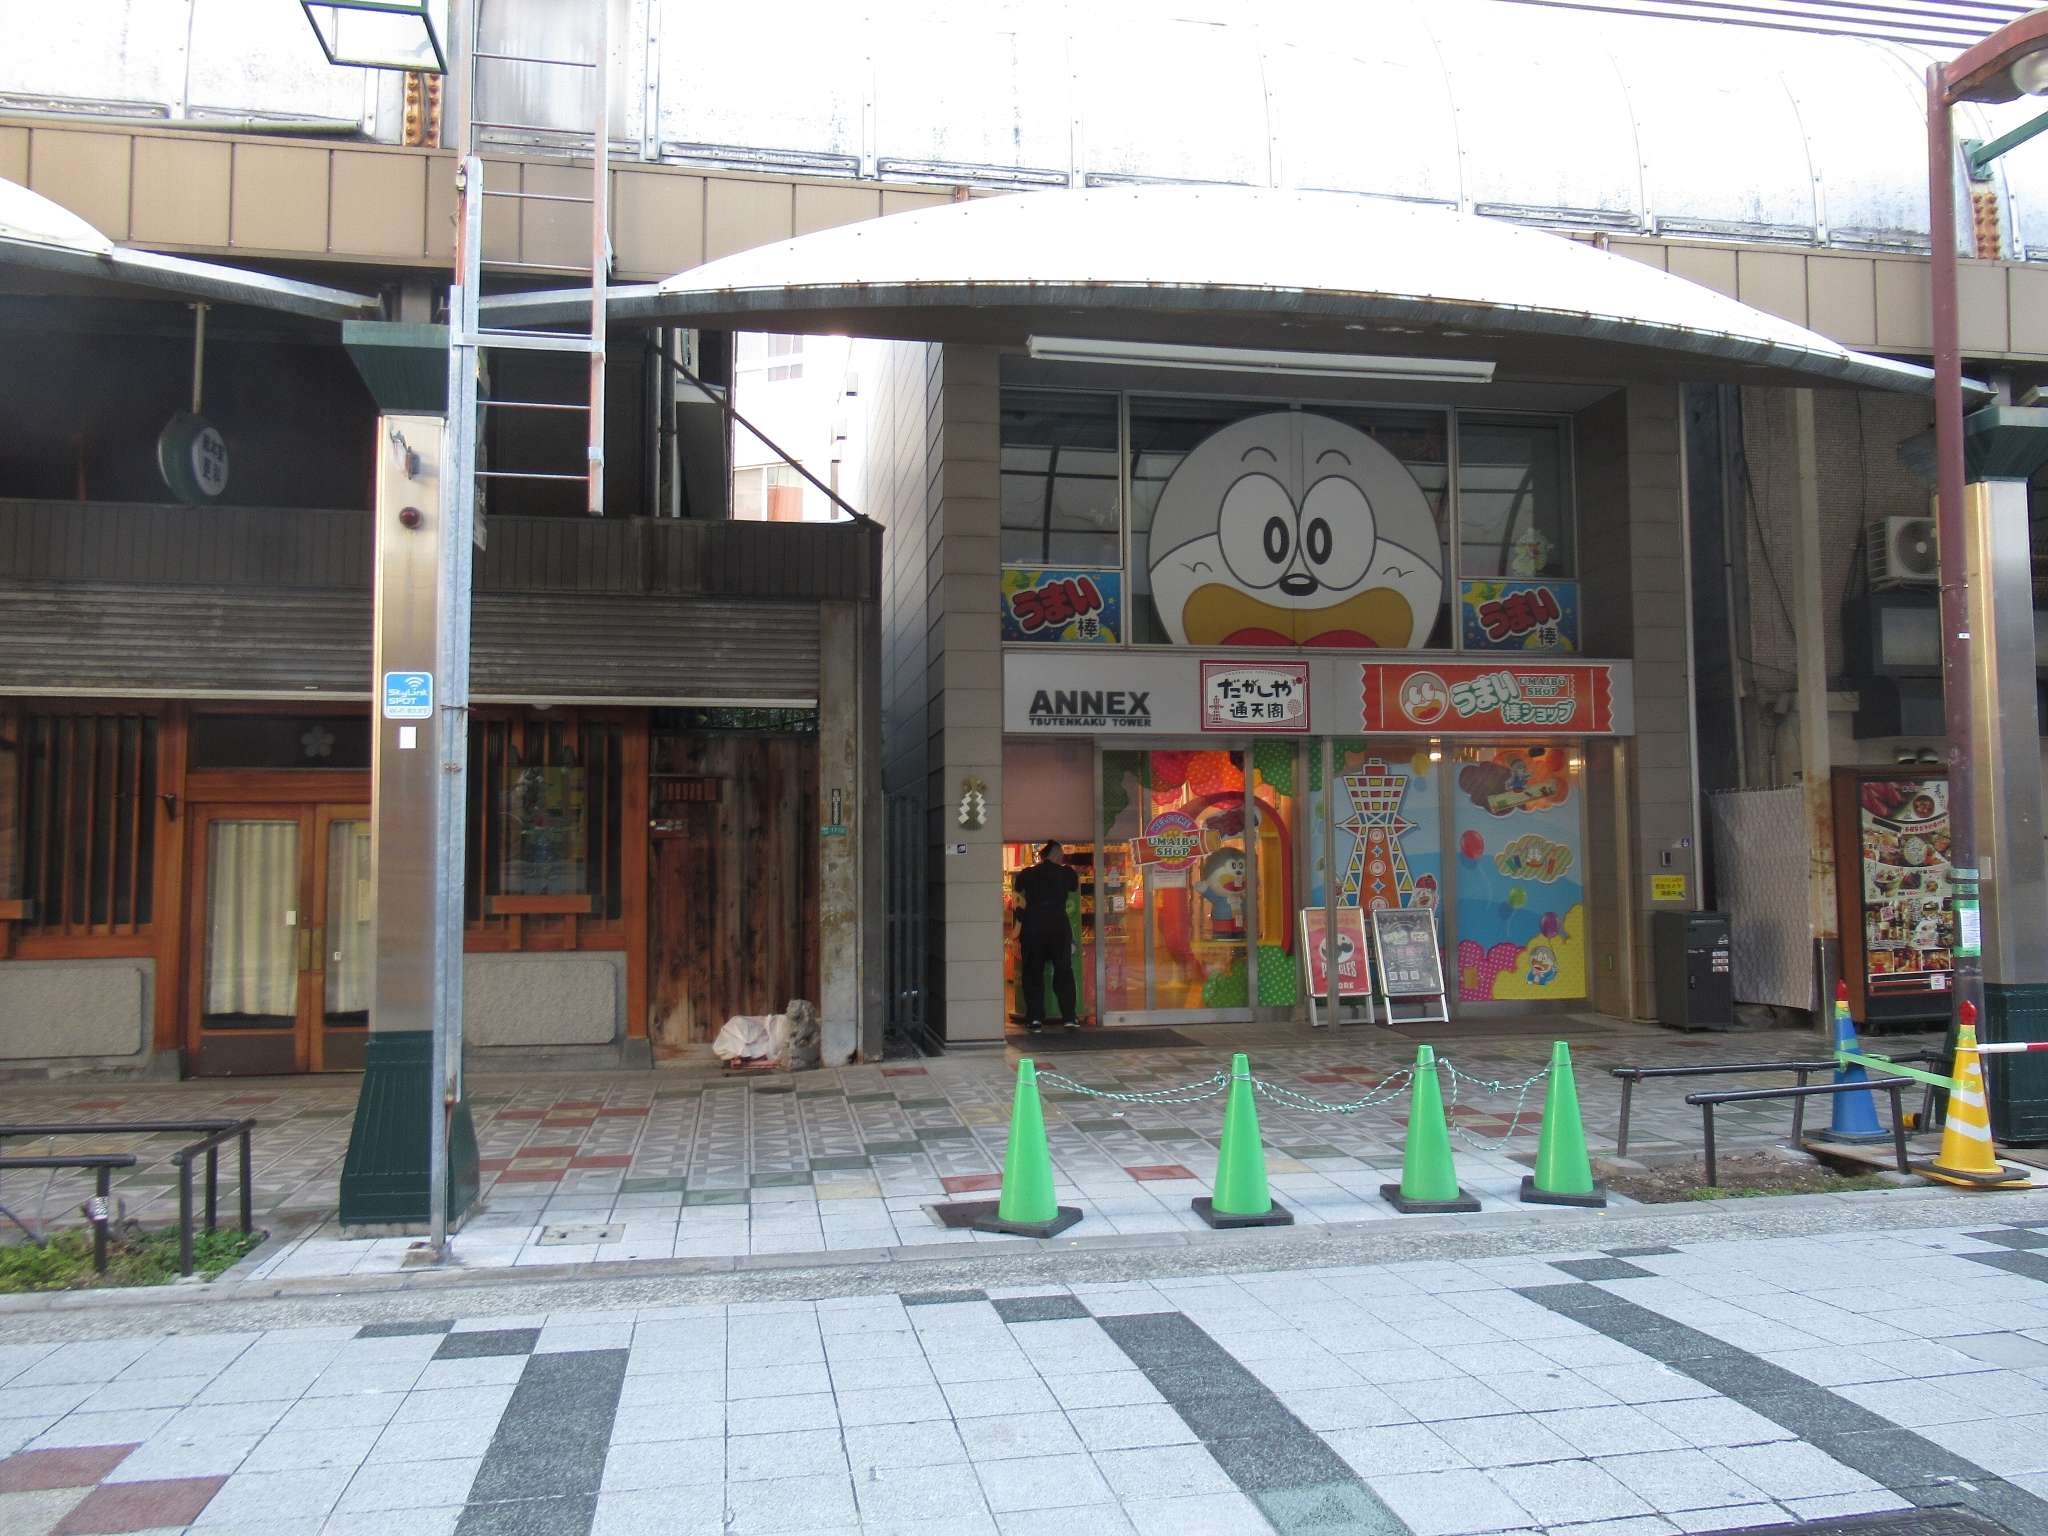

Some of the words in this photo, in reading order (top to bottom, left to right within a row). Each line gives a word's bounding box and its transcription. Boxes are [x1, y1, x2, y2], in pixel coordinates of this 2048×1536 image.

[1012, 576, 1103, 632] うまい
[1478, 588, 1559, 640] うまい
[1078, 617, 1098, 638] 棒
[1538, 625, 1557, 646] 棒
[1217, 679, 1292, 699] だがしや
[1450, 670, 1521, 717] うまい
[1527, 687, 1558, 696] SHOP
[387, 697, 417, 705] SPOT
[1029, 690, 1151, 716] ANNEX
[1230, 701, 1284, 719] 通天閣
[1502, 700, 1575, 723] 棒ショップ
[1029, 717, 1106, 726] TSUTENKAKU
[1112, 718, 1152, 727] TOWER
[1148, 836, 1199, 846] UMAIBO
[1156, 846, 1190, 857] SHOP
